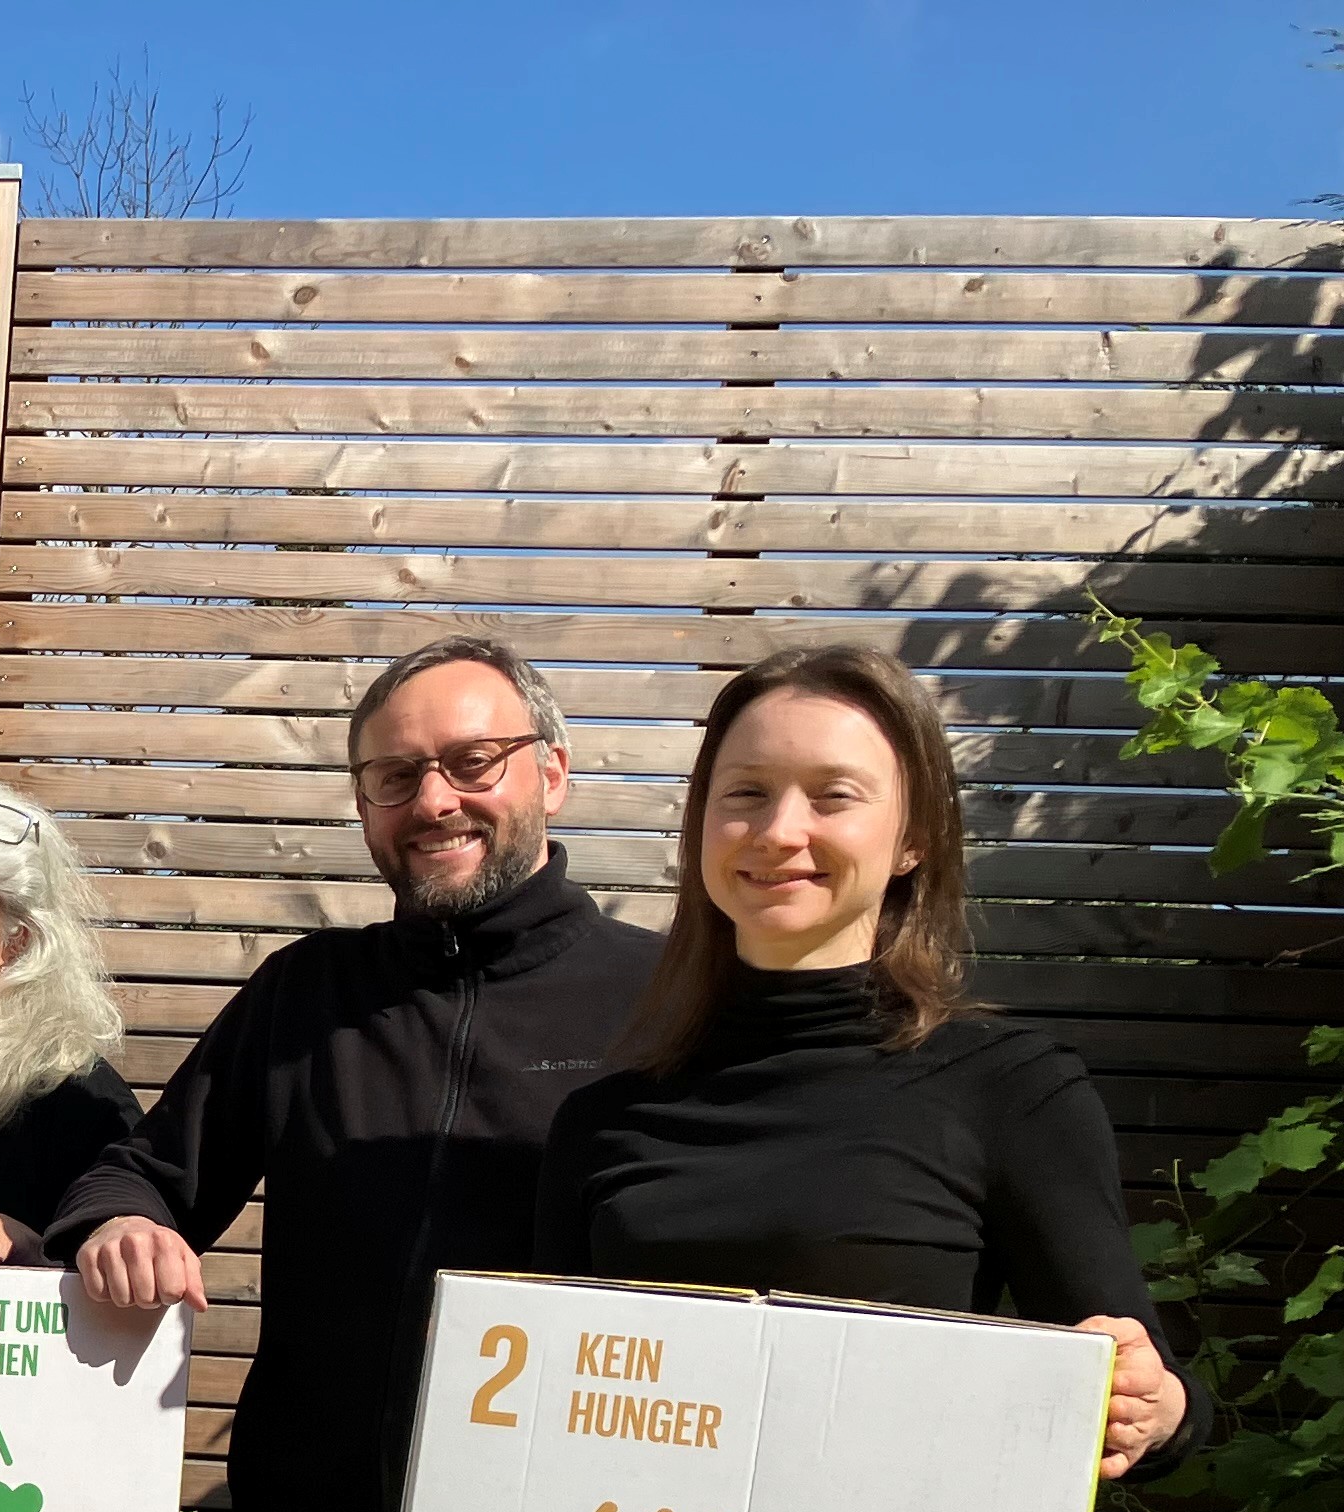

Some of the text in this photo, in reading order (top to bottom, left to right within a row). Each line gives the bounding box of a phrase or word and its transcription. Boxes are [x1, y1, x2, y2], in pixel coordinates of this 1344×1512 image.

[16, 1301, 68, 1334] UND
[470, 1324, 529, 1427] 2
[576, 1331, 663, 1383] KEIN
[566, 1391, 722, 1450] HUNGER
